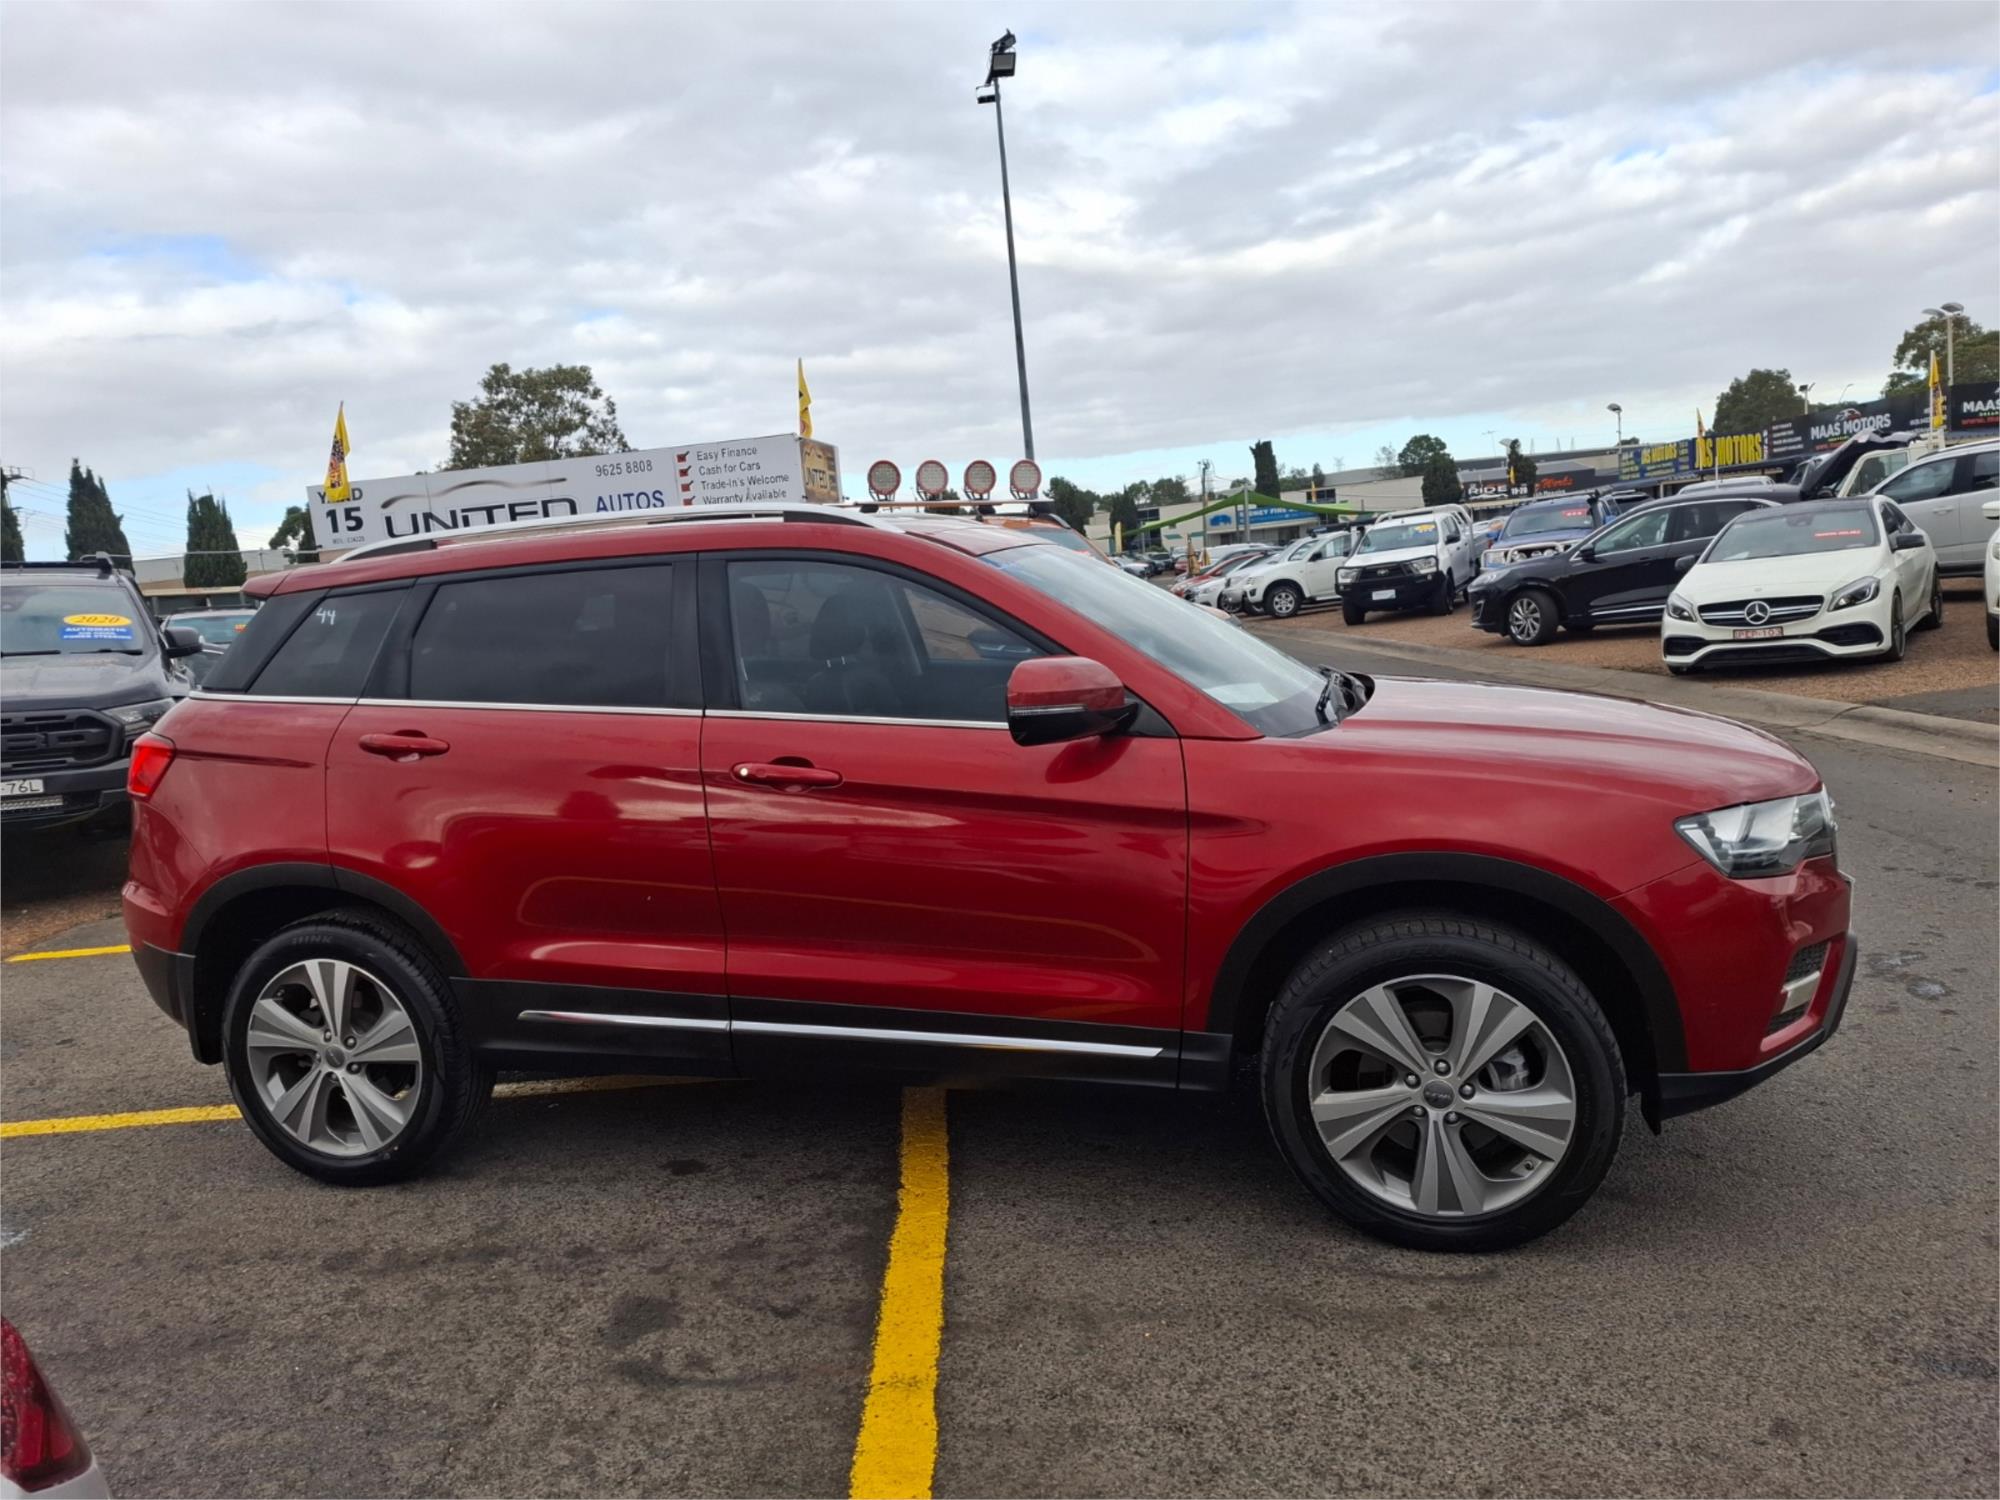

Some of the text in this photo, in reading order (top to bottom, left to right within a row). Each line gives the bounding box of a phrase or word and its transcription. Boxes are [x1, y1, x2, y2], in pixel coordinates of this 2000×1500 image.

[1810, 422, 1841, 440] MAAS
[696, 447, 757, 461] Easy Finance
[1716, 432, 1762, 466] MOTORS
[595, 459, 653, 477] 9625 8808
[698, 461, 761, 476] Cash for Cars
[747, 474, 789, 486] Welcome
[317, 487, 364, 504] YD
[596, 489, 665, 512] AUTOS
[703, 487, 787, 505] Warranty Available
[326, 506, 364, 534] 15
[74, 615, 121, 625] 2020
[316, 608, 336, 625] 44
